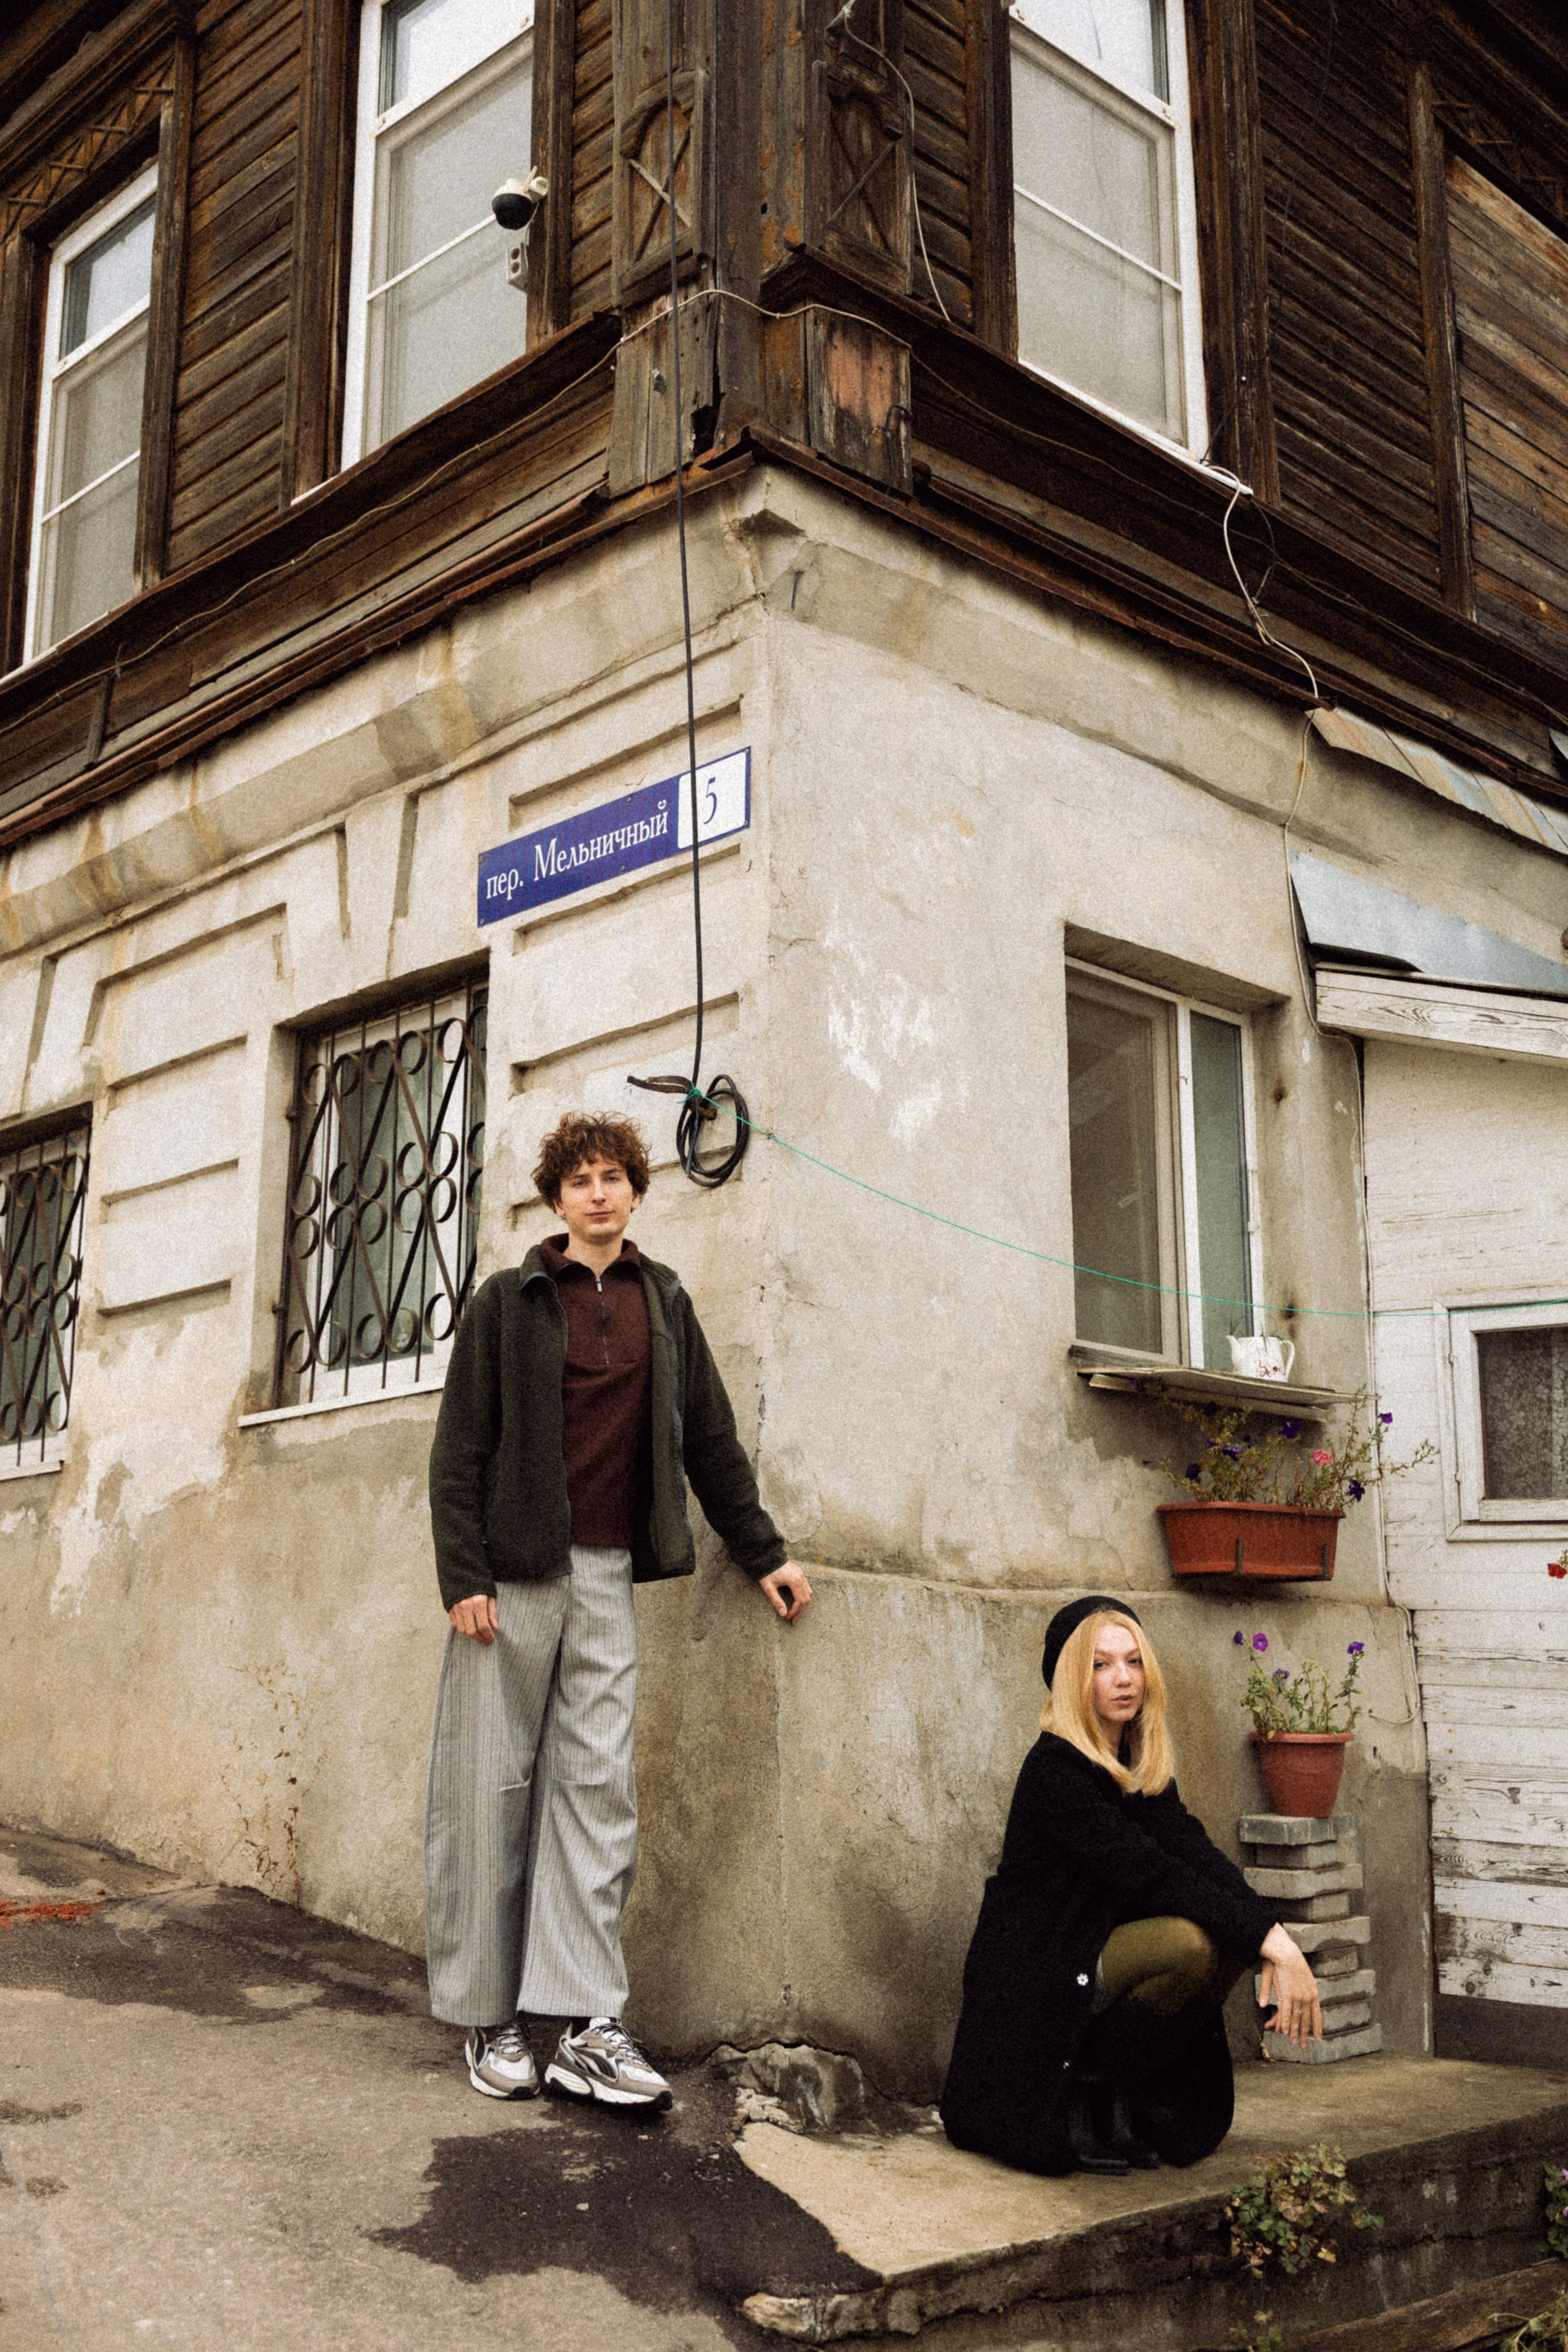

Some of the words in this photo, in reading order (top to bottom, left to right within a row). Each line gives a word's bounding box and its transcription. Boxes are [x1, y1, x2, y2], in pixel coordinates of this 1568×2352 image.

[703, 777, 717, 825] 5
[486, 868, 524, 900] пер.
[533, 799, 668, 881] Мельничный
